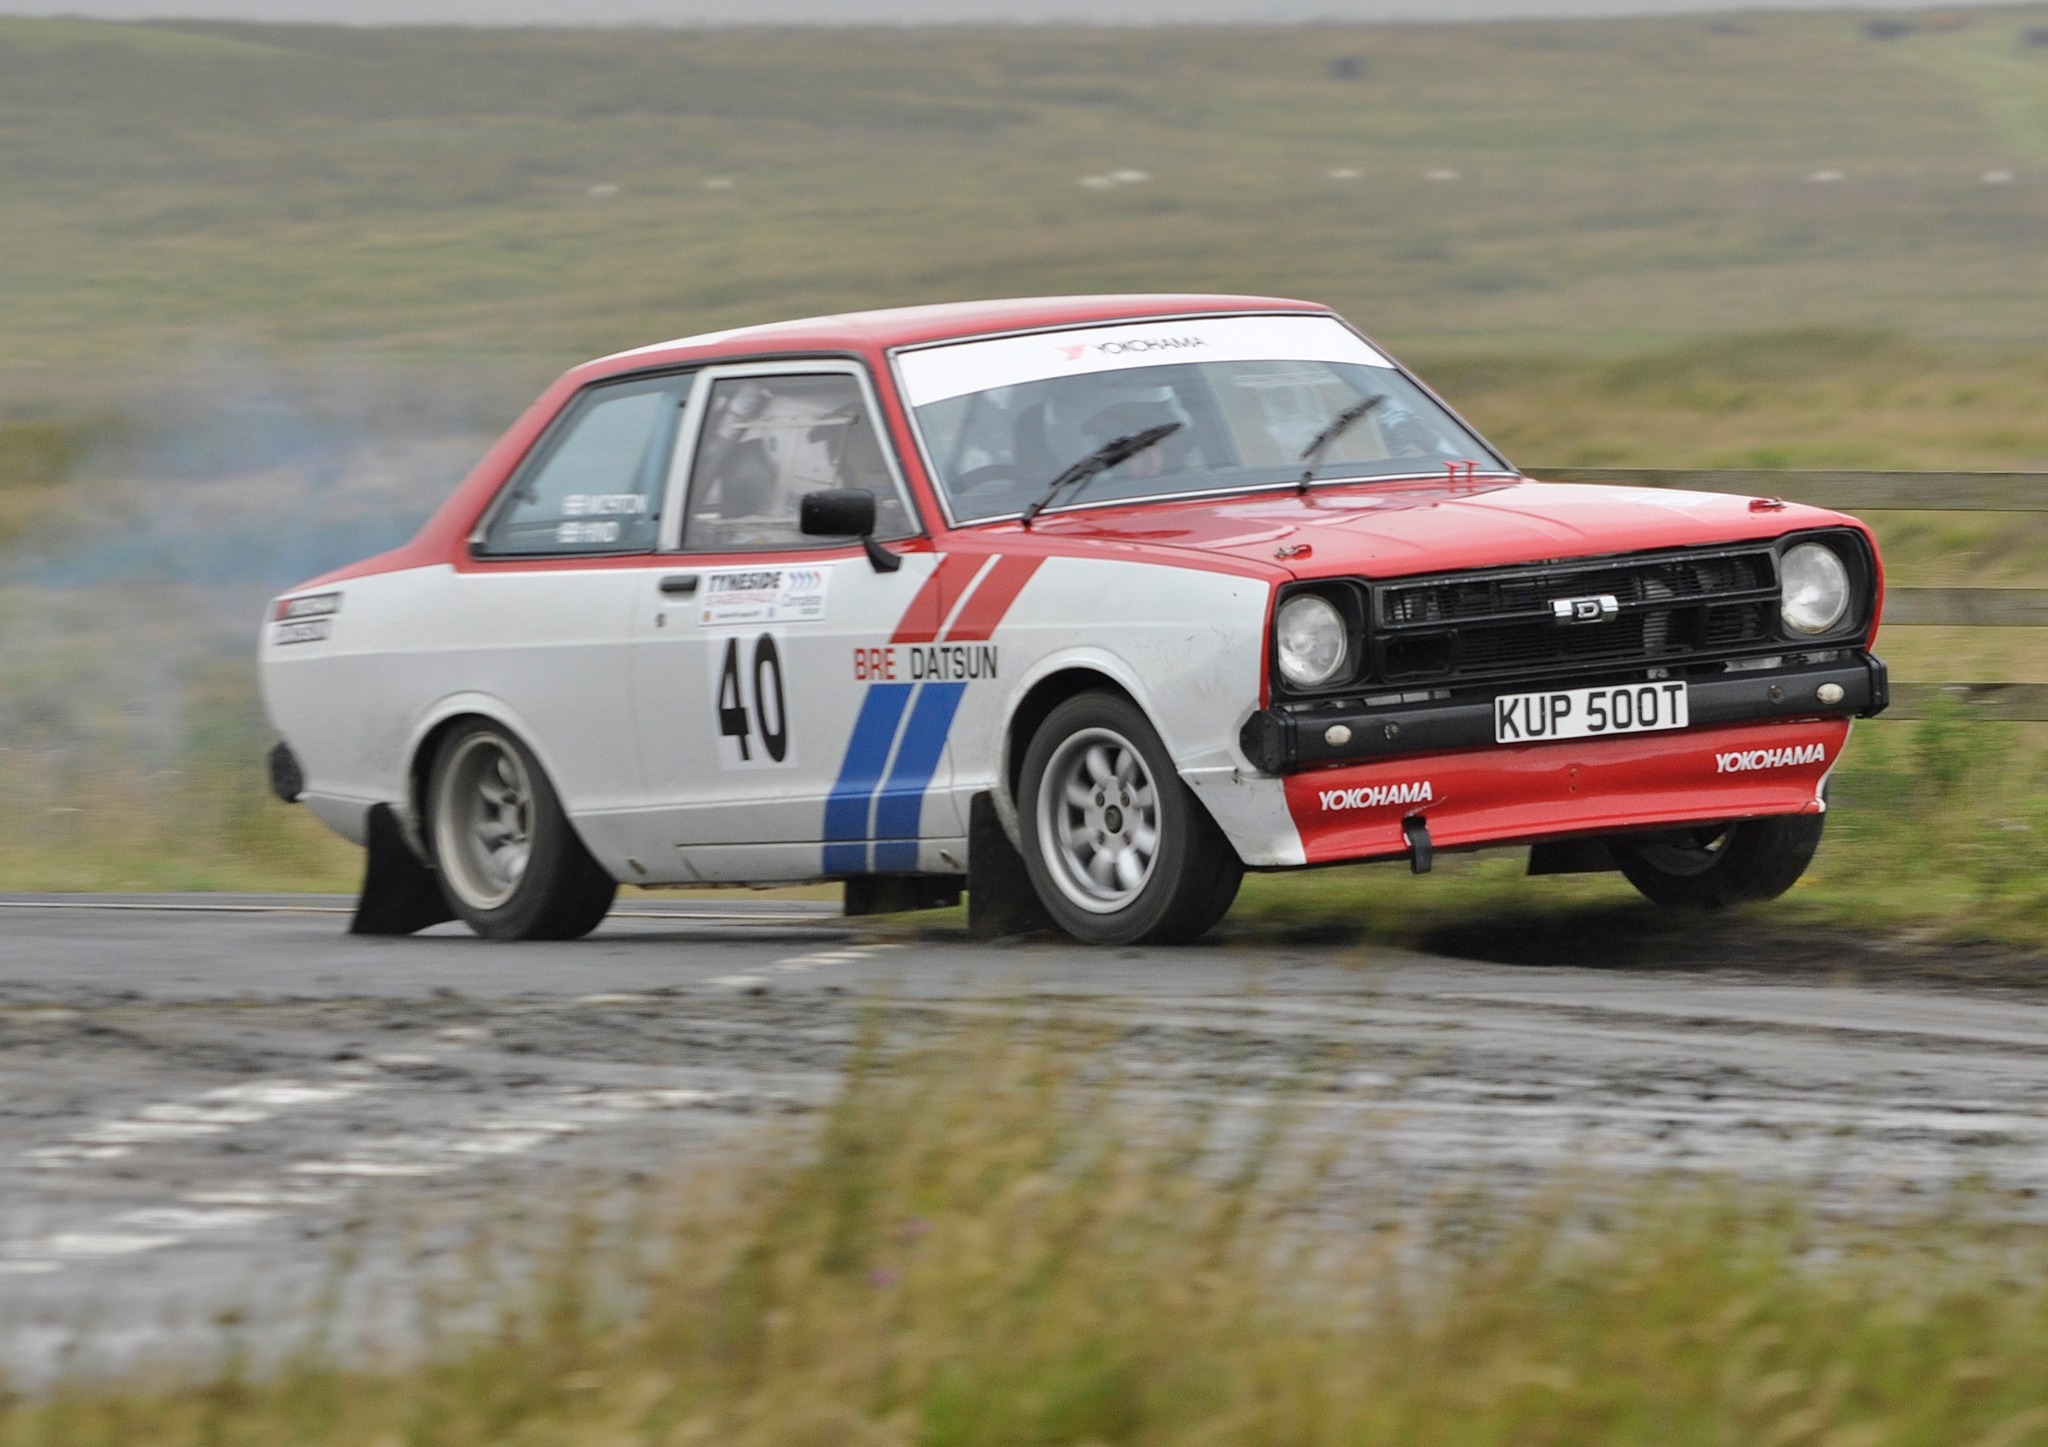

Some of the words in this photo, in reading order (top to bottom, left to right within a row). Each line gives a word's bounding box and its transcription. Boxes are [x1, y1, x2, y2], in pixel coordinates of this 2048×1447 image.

[1091, 336, 1209, 355] YOKOHAMA
[708, 571, 782, 593] TYNESIDE
[854, 648, 896, 680] BRE
[911, 646, 998, 680] DATSUN
[718, 631, 787, 763] 40
[1499, 694, 1571, 740] KUP
[1586, 684, 1684, 732] 500T
[1715, 743, 1825, 773] YOKOHAMA
[1318, 781, 1433, 811] YOKOHAMA
